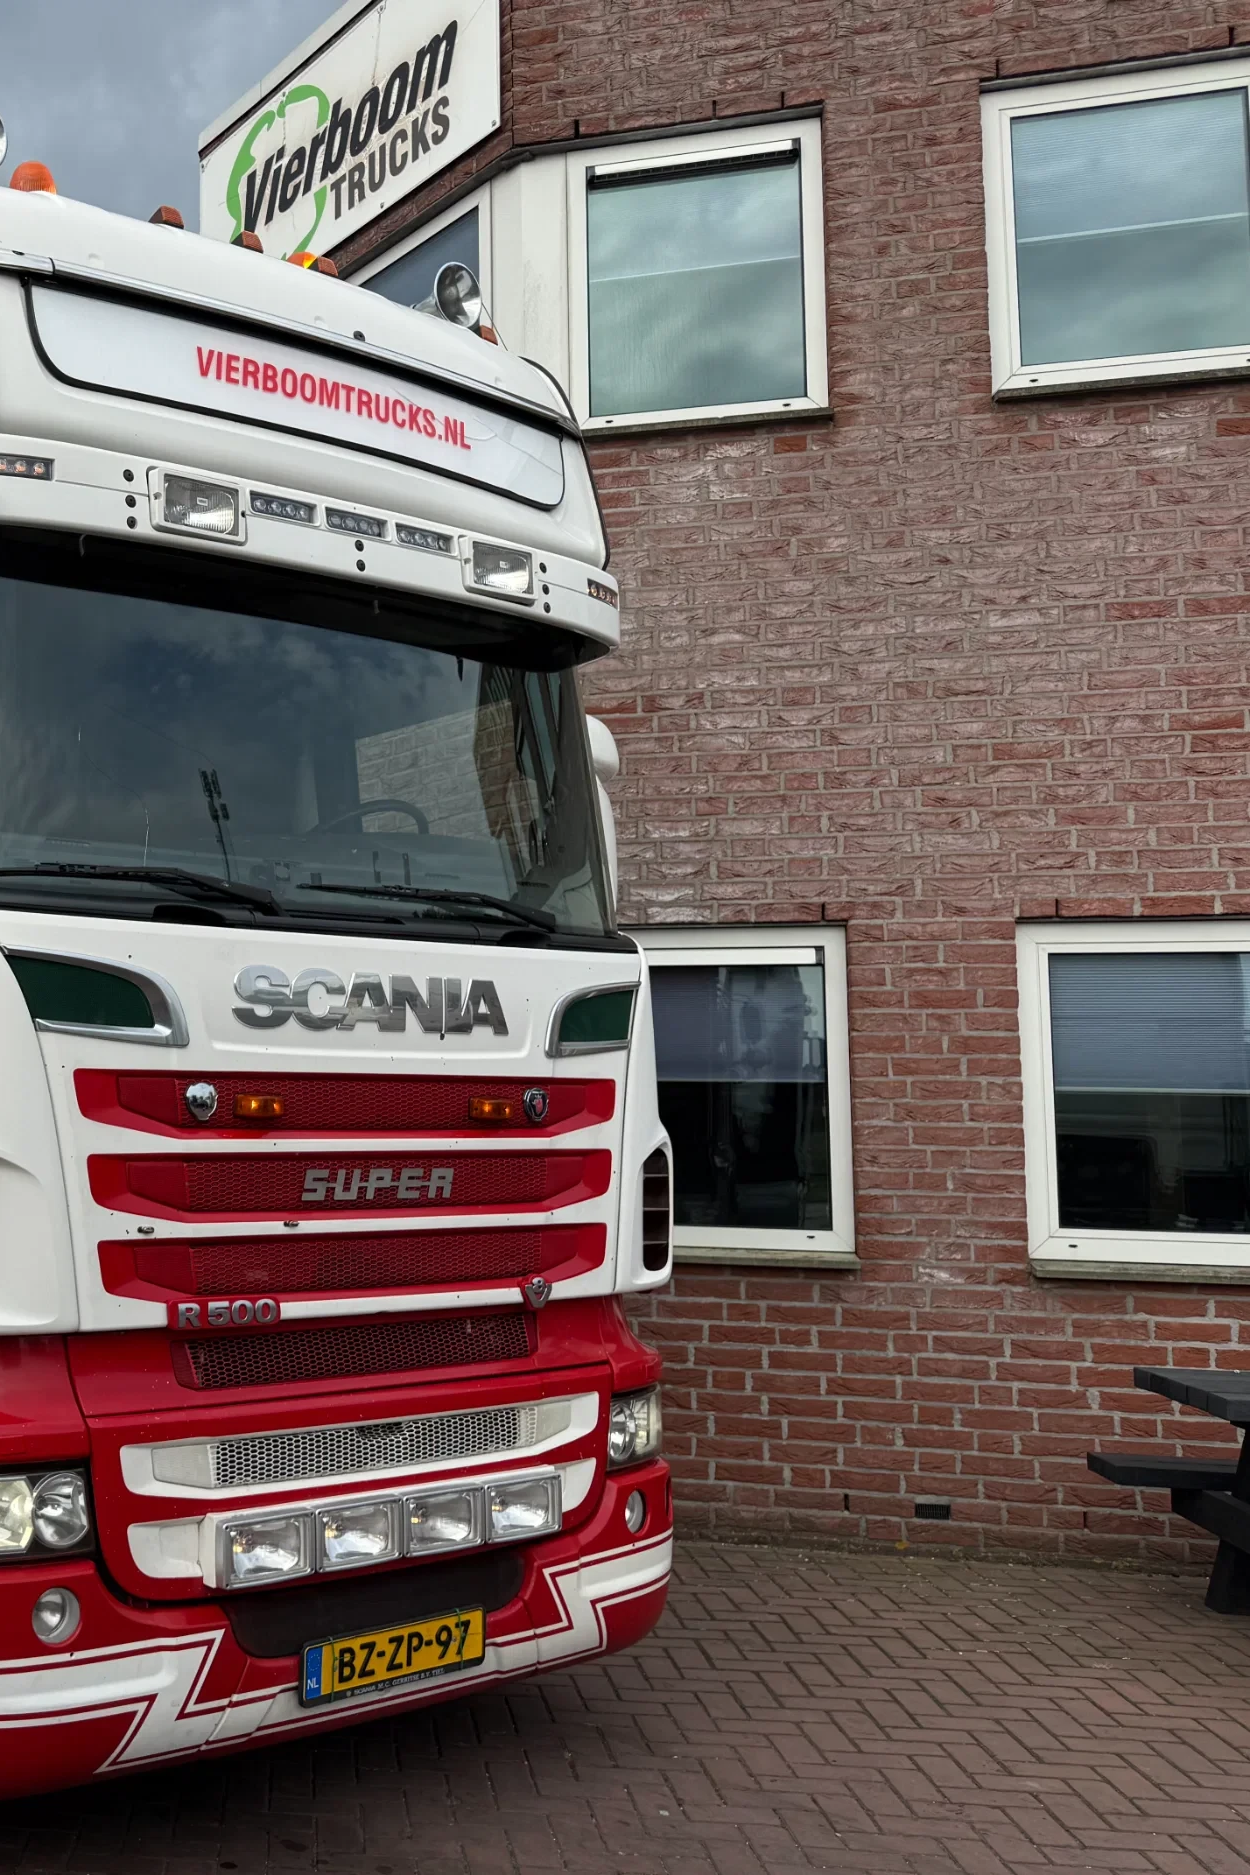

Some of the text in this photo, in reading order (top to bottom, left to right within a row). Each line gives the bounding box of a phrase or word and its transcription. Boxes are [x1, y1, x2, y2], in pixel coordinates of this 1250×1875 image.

[244, 20, 458, 233] Vierboom
[330, 95, 450, 220] TRUCKS
[196, 346, 472, 450] VIERBOOMTRUCKS.NL
[232, 964, 509, 1036] SCANIA
[301, 1168, 454, 1201] SUPER
[177, 1298, 277, 1328] R 500
[307, 1676, 320, 1690] NL
[338, 1619, 471, 1683] BZ-ZP-97
